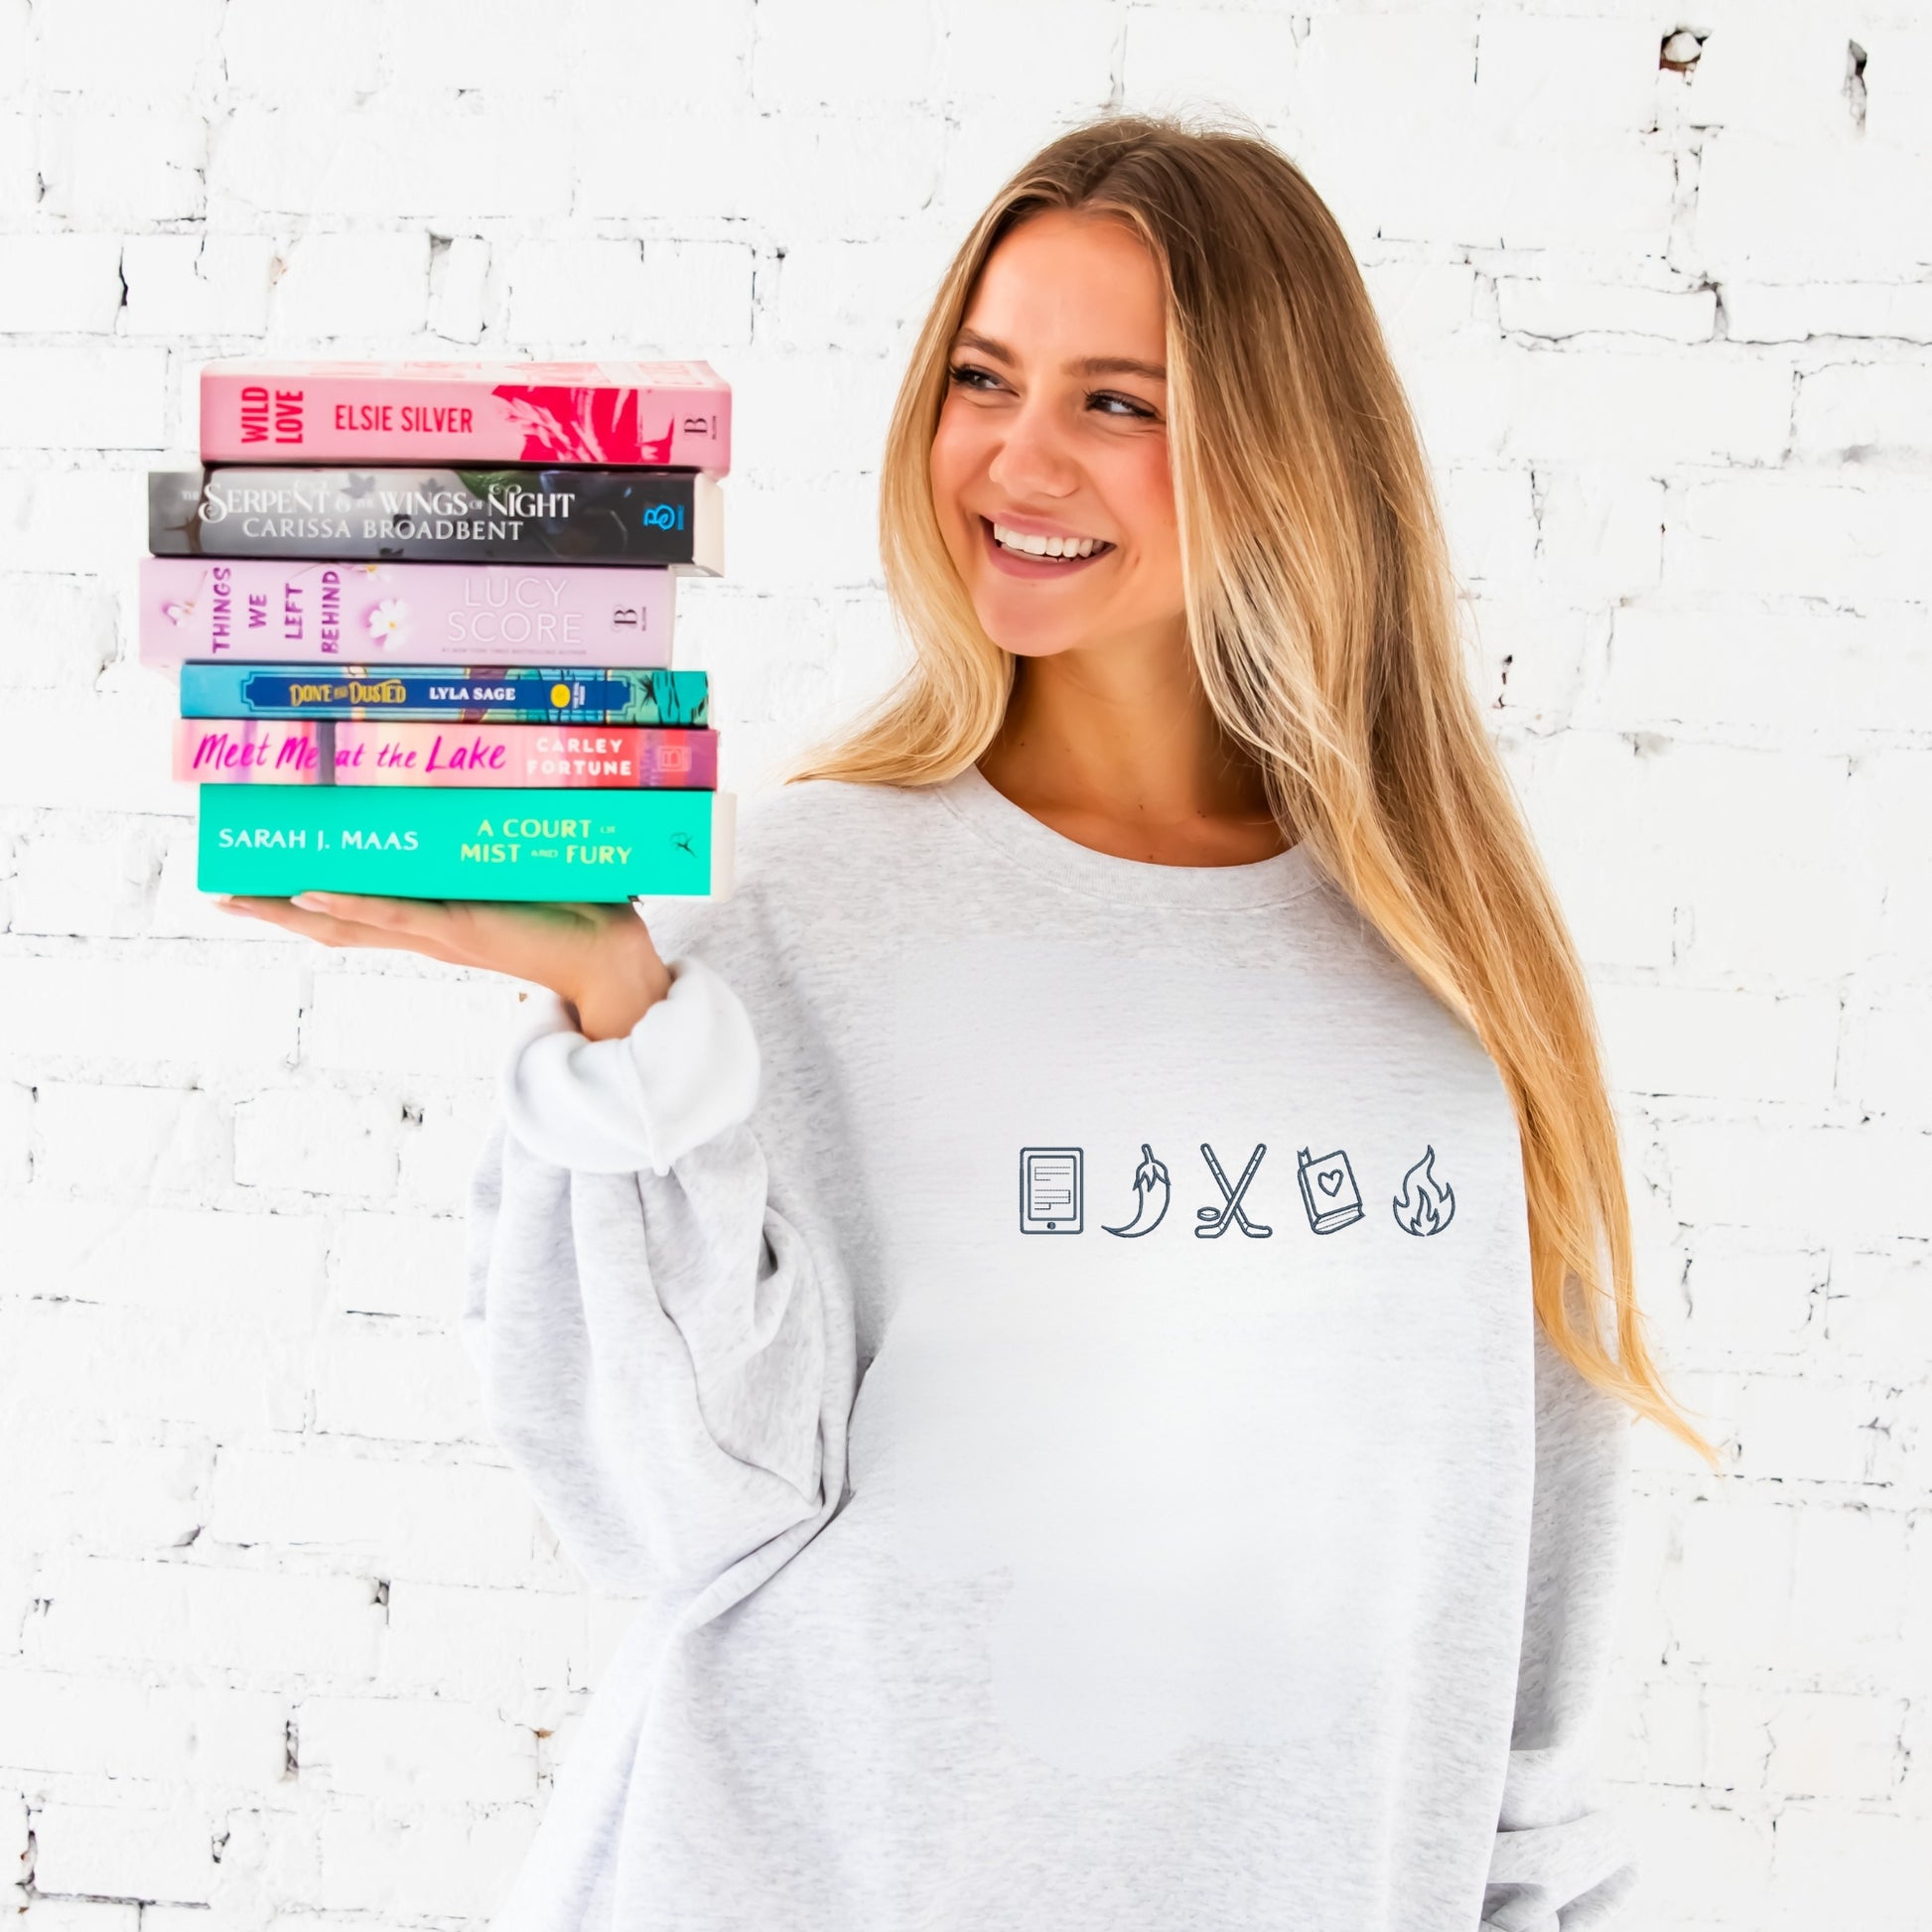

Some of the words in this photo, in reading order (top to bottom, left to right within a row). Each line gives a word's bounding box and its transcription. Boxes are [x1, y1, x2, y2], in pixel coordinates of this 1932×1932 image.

[240, 386, 269, 444] WILD
[275, 389, 304, 444] LOVE
[335, 404, 393, 432] ELSIE
[401, 405, 474, 434] SILVER
[199, 482, 330, 523] SERPENT
[378, 490, 469, 516] WINGS
[487, 483, 576, 518] NIGHT
[241, 516, 351, 539] CARISSA
[362, 518, 524, 541] BROADBENT
[464, 577, 568, 609] LUCY
[211, 566, 231, 654] THINGS
[247, 593, 268, 628] WE
[284, 582, 304, 640] LEFT
[321, 570, 341, 654] BEHIND
[447, 610, 583, 643] SCORE
[289, 683, 334, 707] DONE
[348, 678, 407, 705] DUSTED
[429, 686, 471, 701] LYLA
[472, 686, 517, 701] SAGE
[193, 733, 273, 770] Meet
[274, 736, 321, 770] Me
[334, 743, 366, 767] at
[376, 742, 418, 768] the
[424, 735, 507, 773] Lake
[535, 737, 624, 755] CARLEY
[526, 759, 633, 776] FORTUNE
[217, 827, 307, 849] SARAH
[316, 829, 331, 852] J.
[340, 829, 420, 851] MAAS
[476, 818, 494, 838] A
[501, 818, 593, 838] COURT
[460, 843, 522, 863] MIST
[565, 844, 633, 865] FURY
